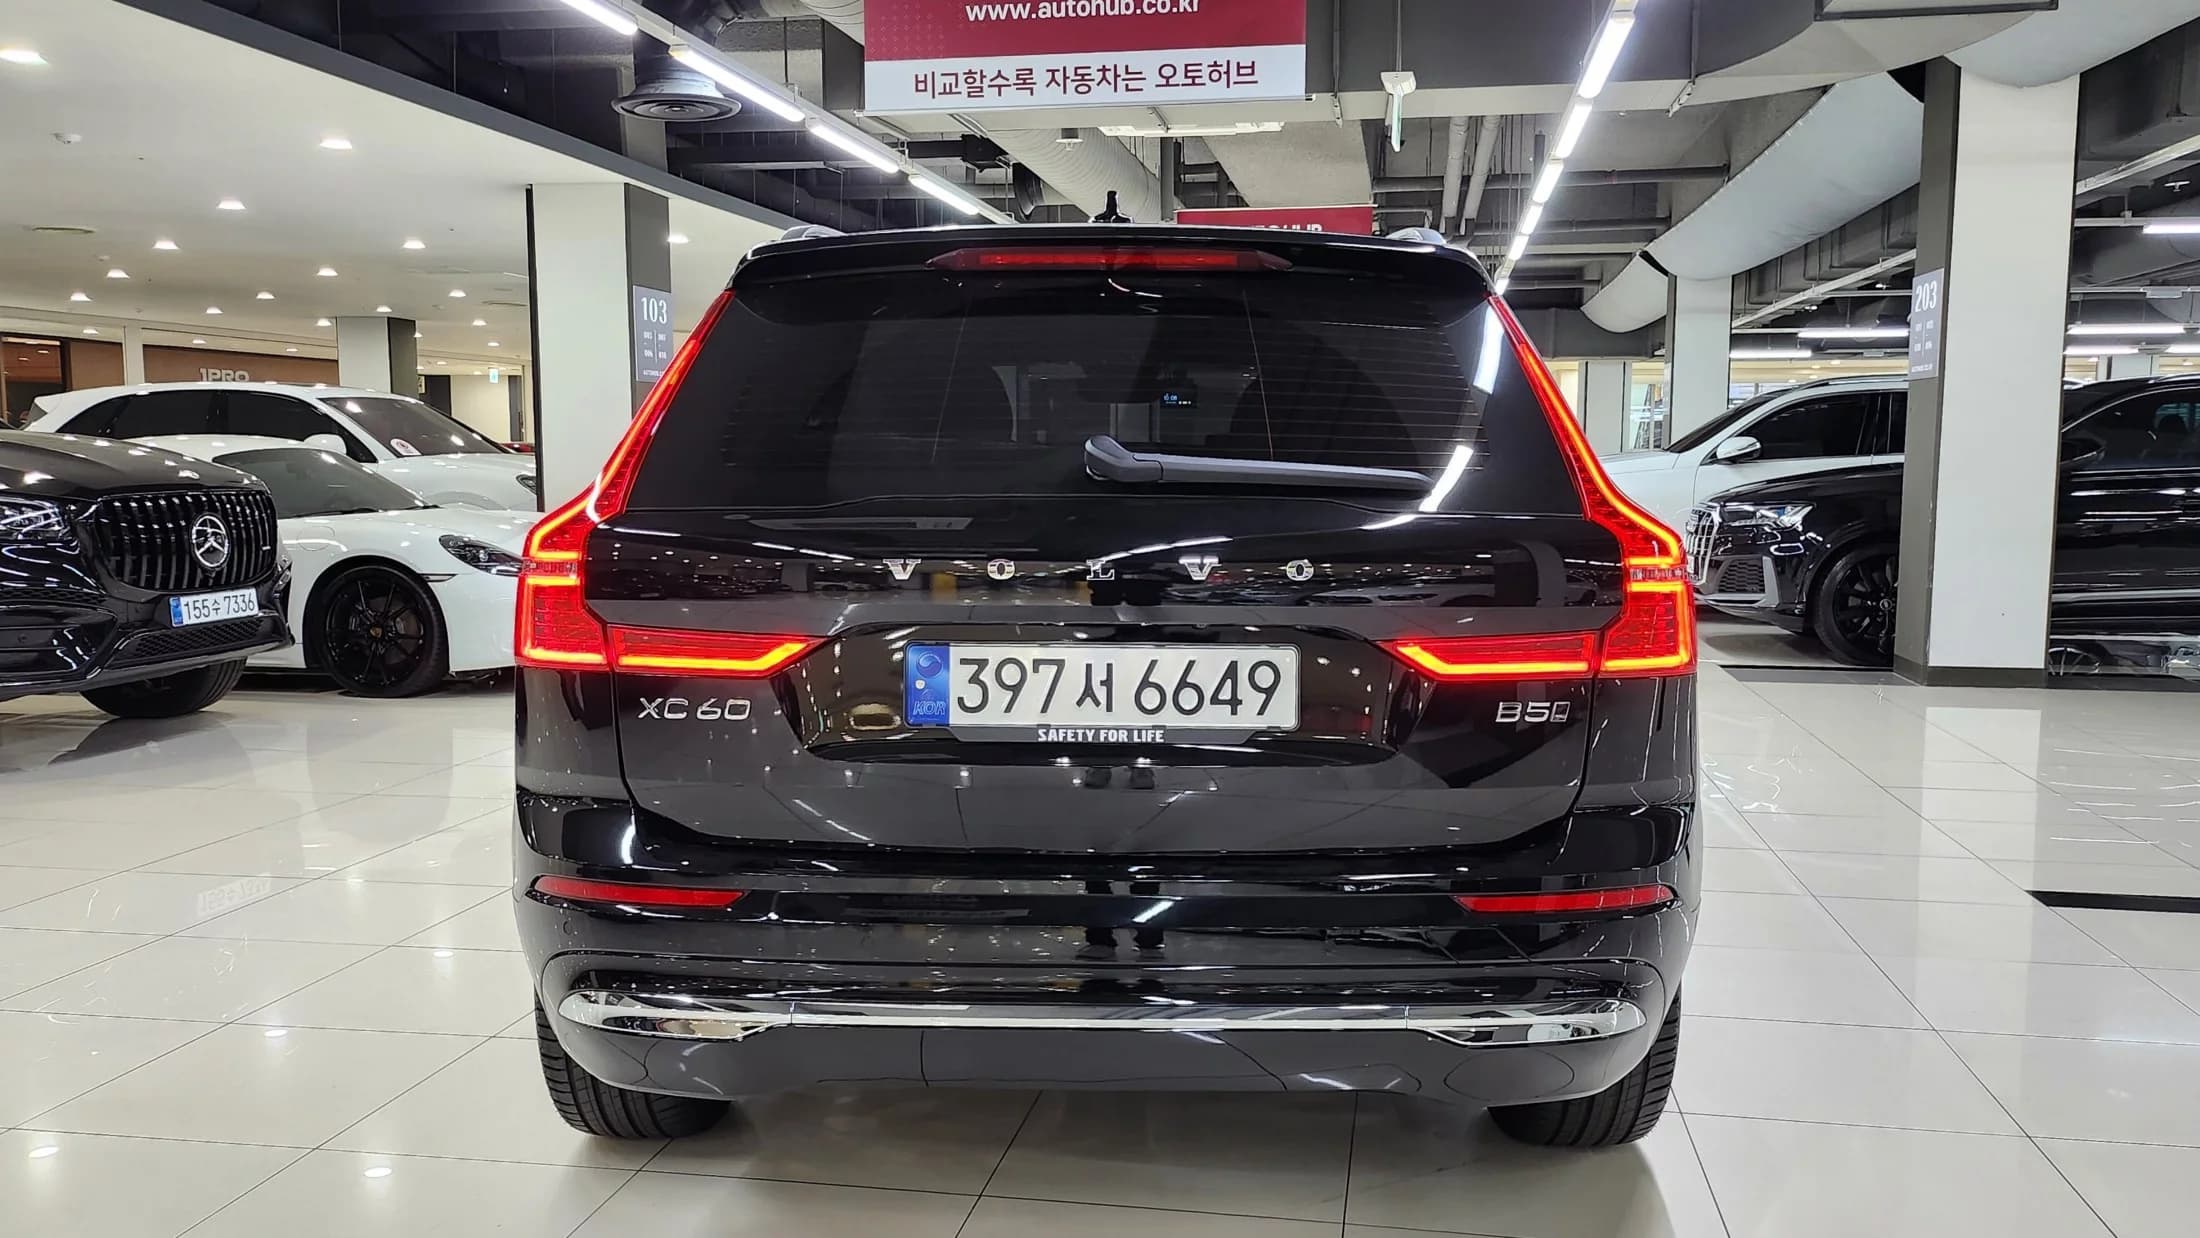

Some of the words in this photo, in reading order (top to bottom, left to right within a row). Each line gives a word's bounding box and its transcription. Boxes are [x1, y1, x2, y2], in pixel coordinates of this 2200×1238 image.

[914, 68, 1037, 99] 비교할수록
[1045, 63, 1147, 95] 자동차는
[1155, 59, 1259, 90] 오토허브
[641, 297, 667, 325] 103
[1915, 280, 1937, 312] 203
[1037, 729, 1095, 742] SAFETY
[1100, 729, 1128, 742] FOR
[1133, 729, 1164, 743] LIFE
